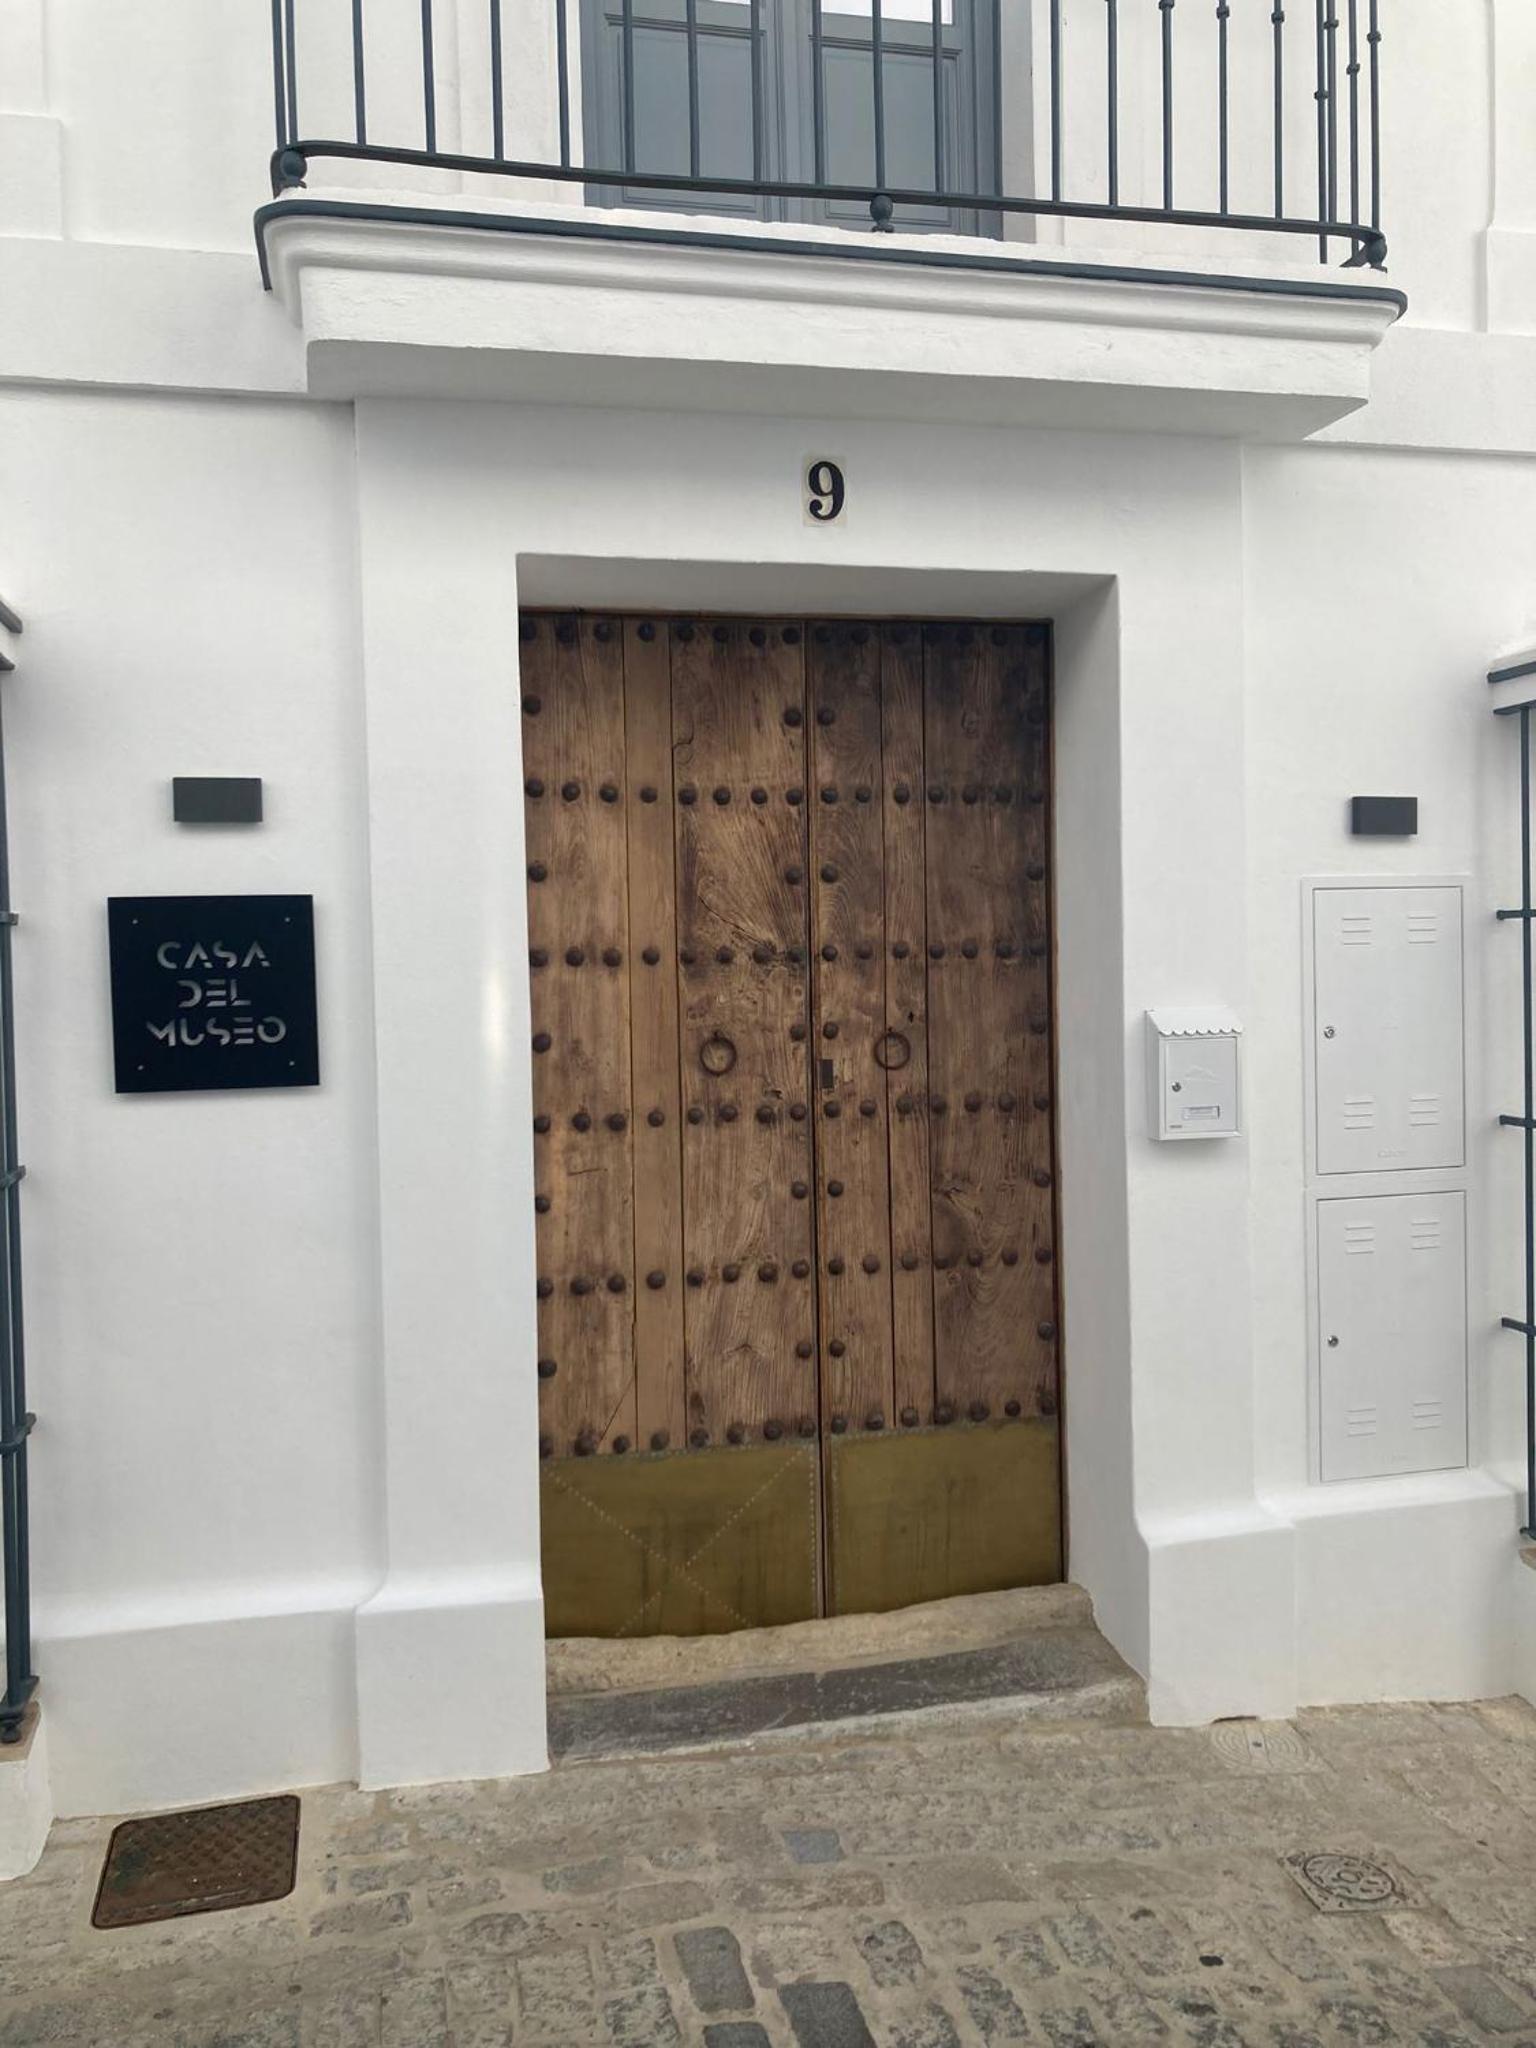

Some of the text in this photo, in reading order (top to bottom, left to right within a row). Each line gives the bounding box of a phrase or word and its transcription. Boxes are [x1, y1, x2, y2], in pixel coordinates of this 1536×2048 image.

[808, 460, 845, 520] 9
[157, 940, 270, 969] CASA
[176, 979, 251, 1008] DEL
[146, 1016, 287, 1046] MUSEO
